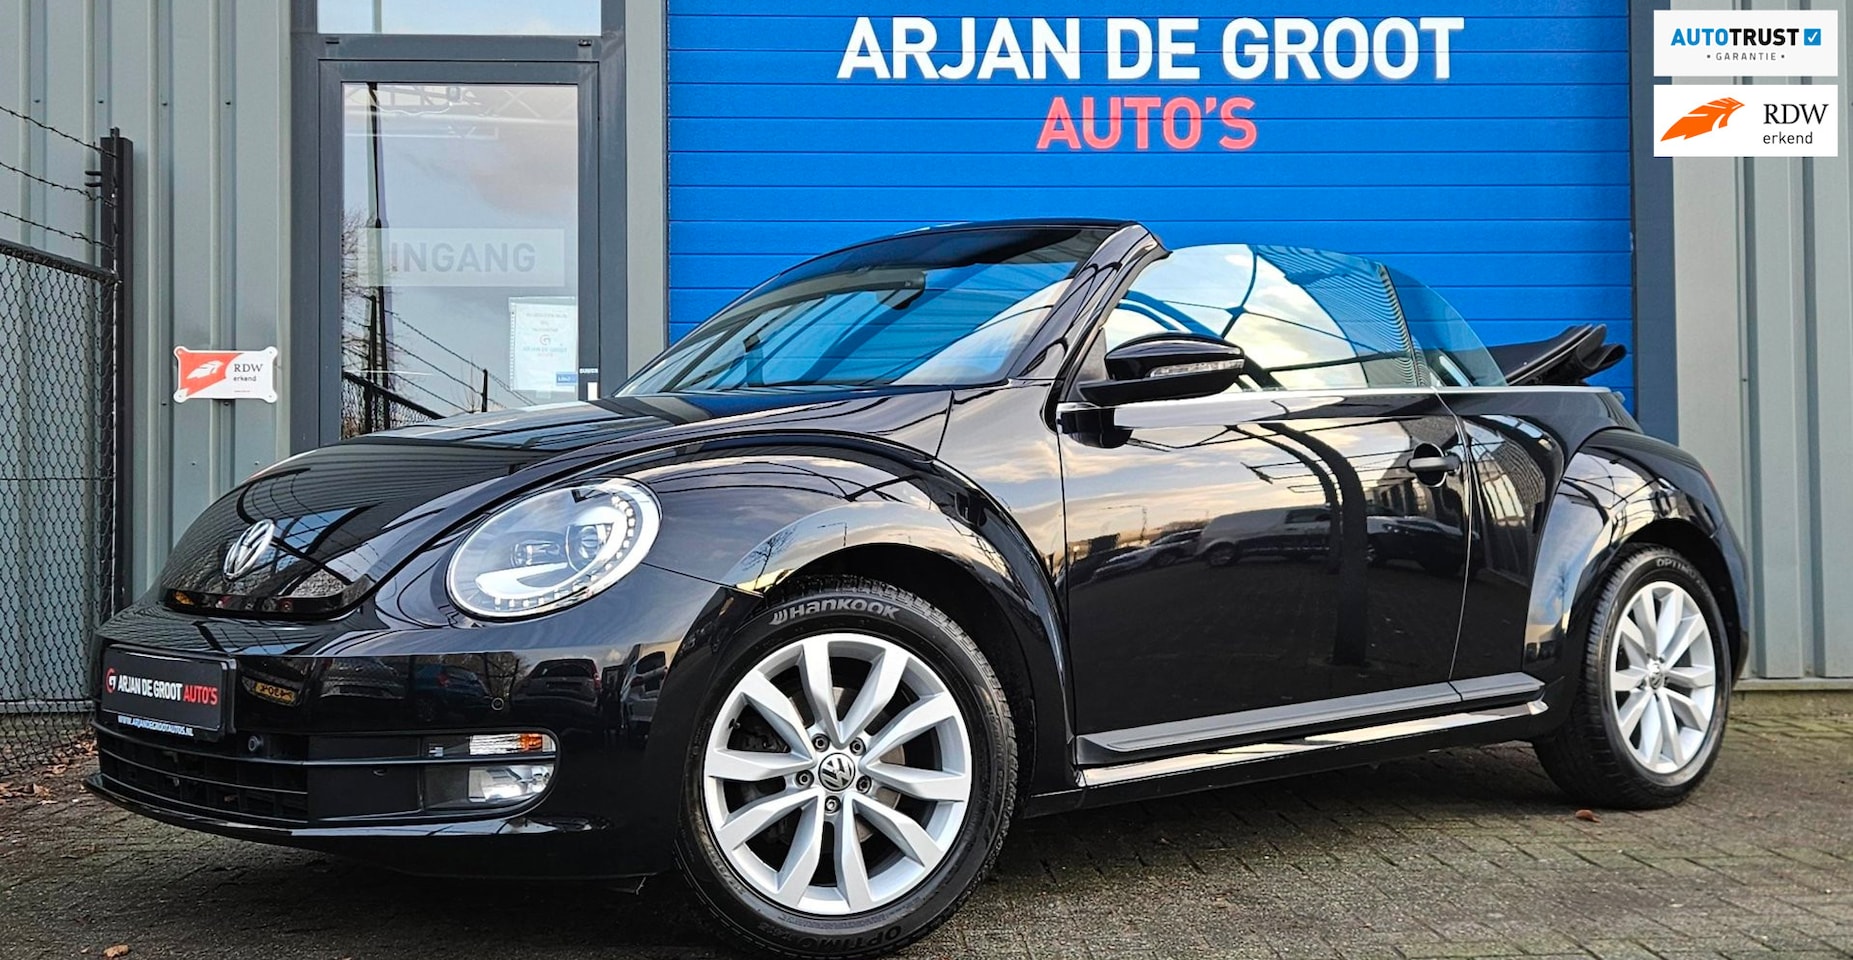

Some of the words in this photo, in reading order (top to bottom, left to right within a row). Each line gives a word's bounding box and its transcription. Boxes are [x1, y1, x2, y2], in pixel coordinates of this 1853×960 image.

[836, 17, 1081, 80] ARJAN
[1106, 17, 1201, 80] DE
[1222, 17, 1465, 80] GROOT
[1036, 96, 1258, 150] AUTO'S
[391, 242, 537, 273] INGANG
[233, 363, 263, 373] RDW
[117, 674, 142, 695] ARJAN
[141, 679, 154, 697] DE
[153, 680, 184, 701] GROOT
[183, 685, 218, 705] AUTO'S
